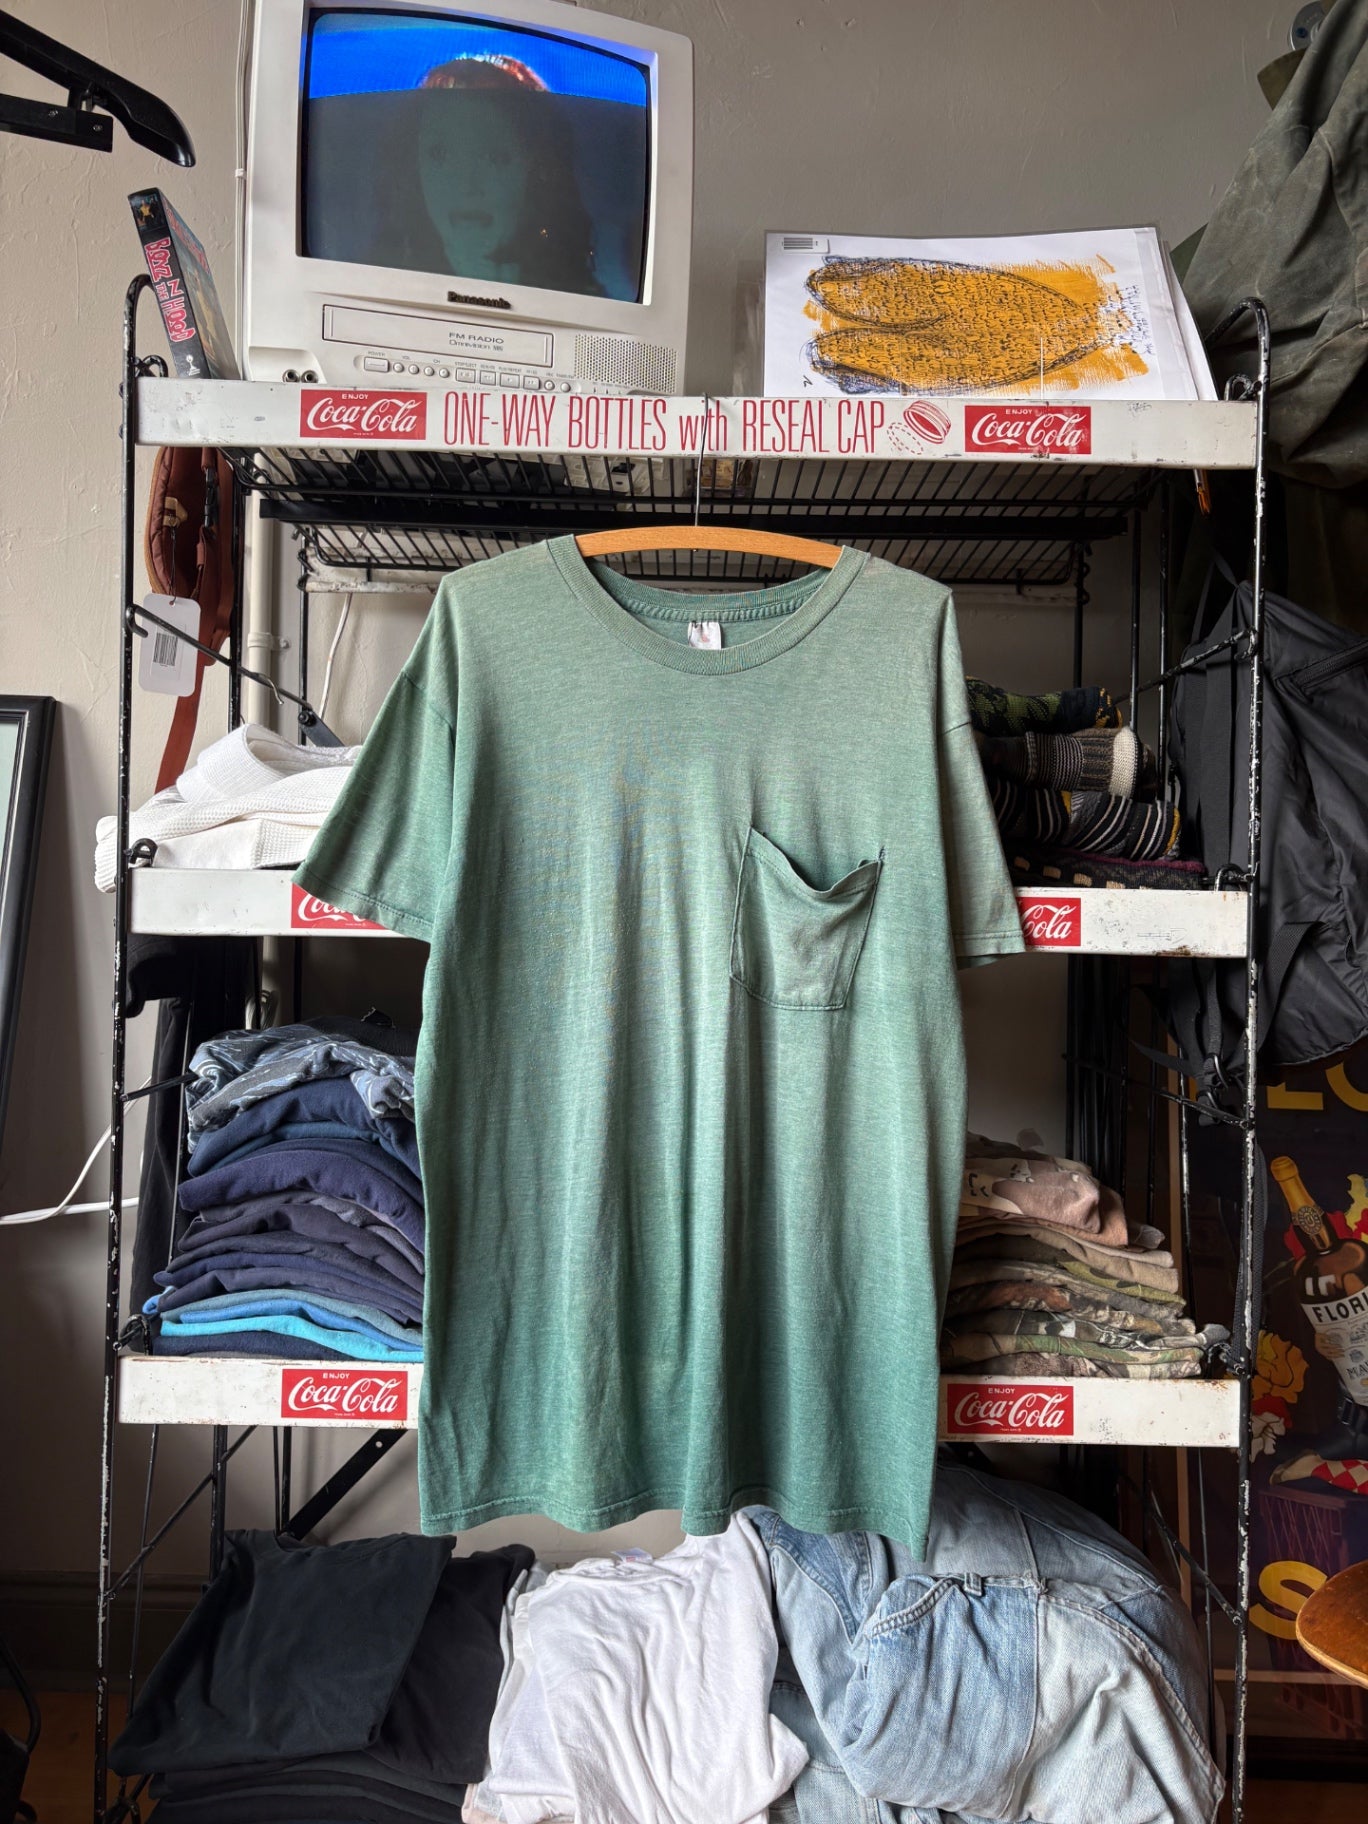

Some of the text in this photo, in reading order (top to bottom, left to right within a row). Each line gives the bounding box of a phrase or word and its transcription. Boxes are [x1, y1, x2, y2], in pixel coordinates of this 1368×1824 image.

[155, 282, 169, 301] THE
[167, 279, 184, 297] N
[161, 297, 196, 342] HOOD
[468, 335, 504, 344] RADIO
[306, 397, 422, 432] Coca-Cola
[443, 391, 884, 453] ONE-WAY BOTTLES with RESEAL CAP
[972, 413, 1086, 447] Coca-Cola
[288, 1377, 402, 1412] Coca-Cola
[954, 1392, 1069, 1428] Coca-Cola
